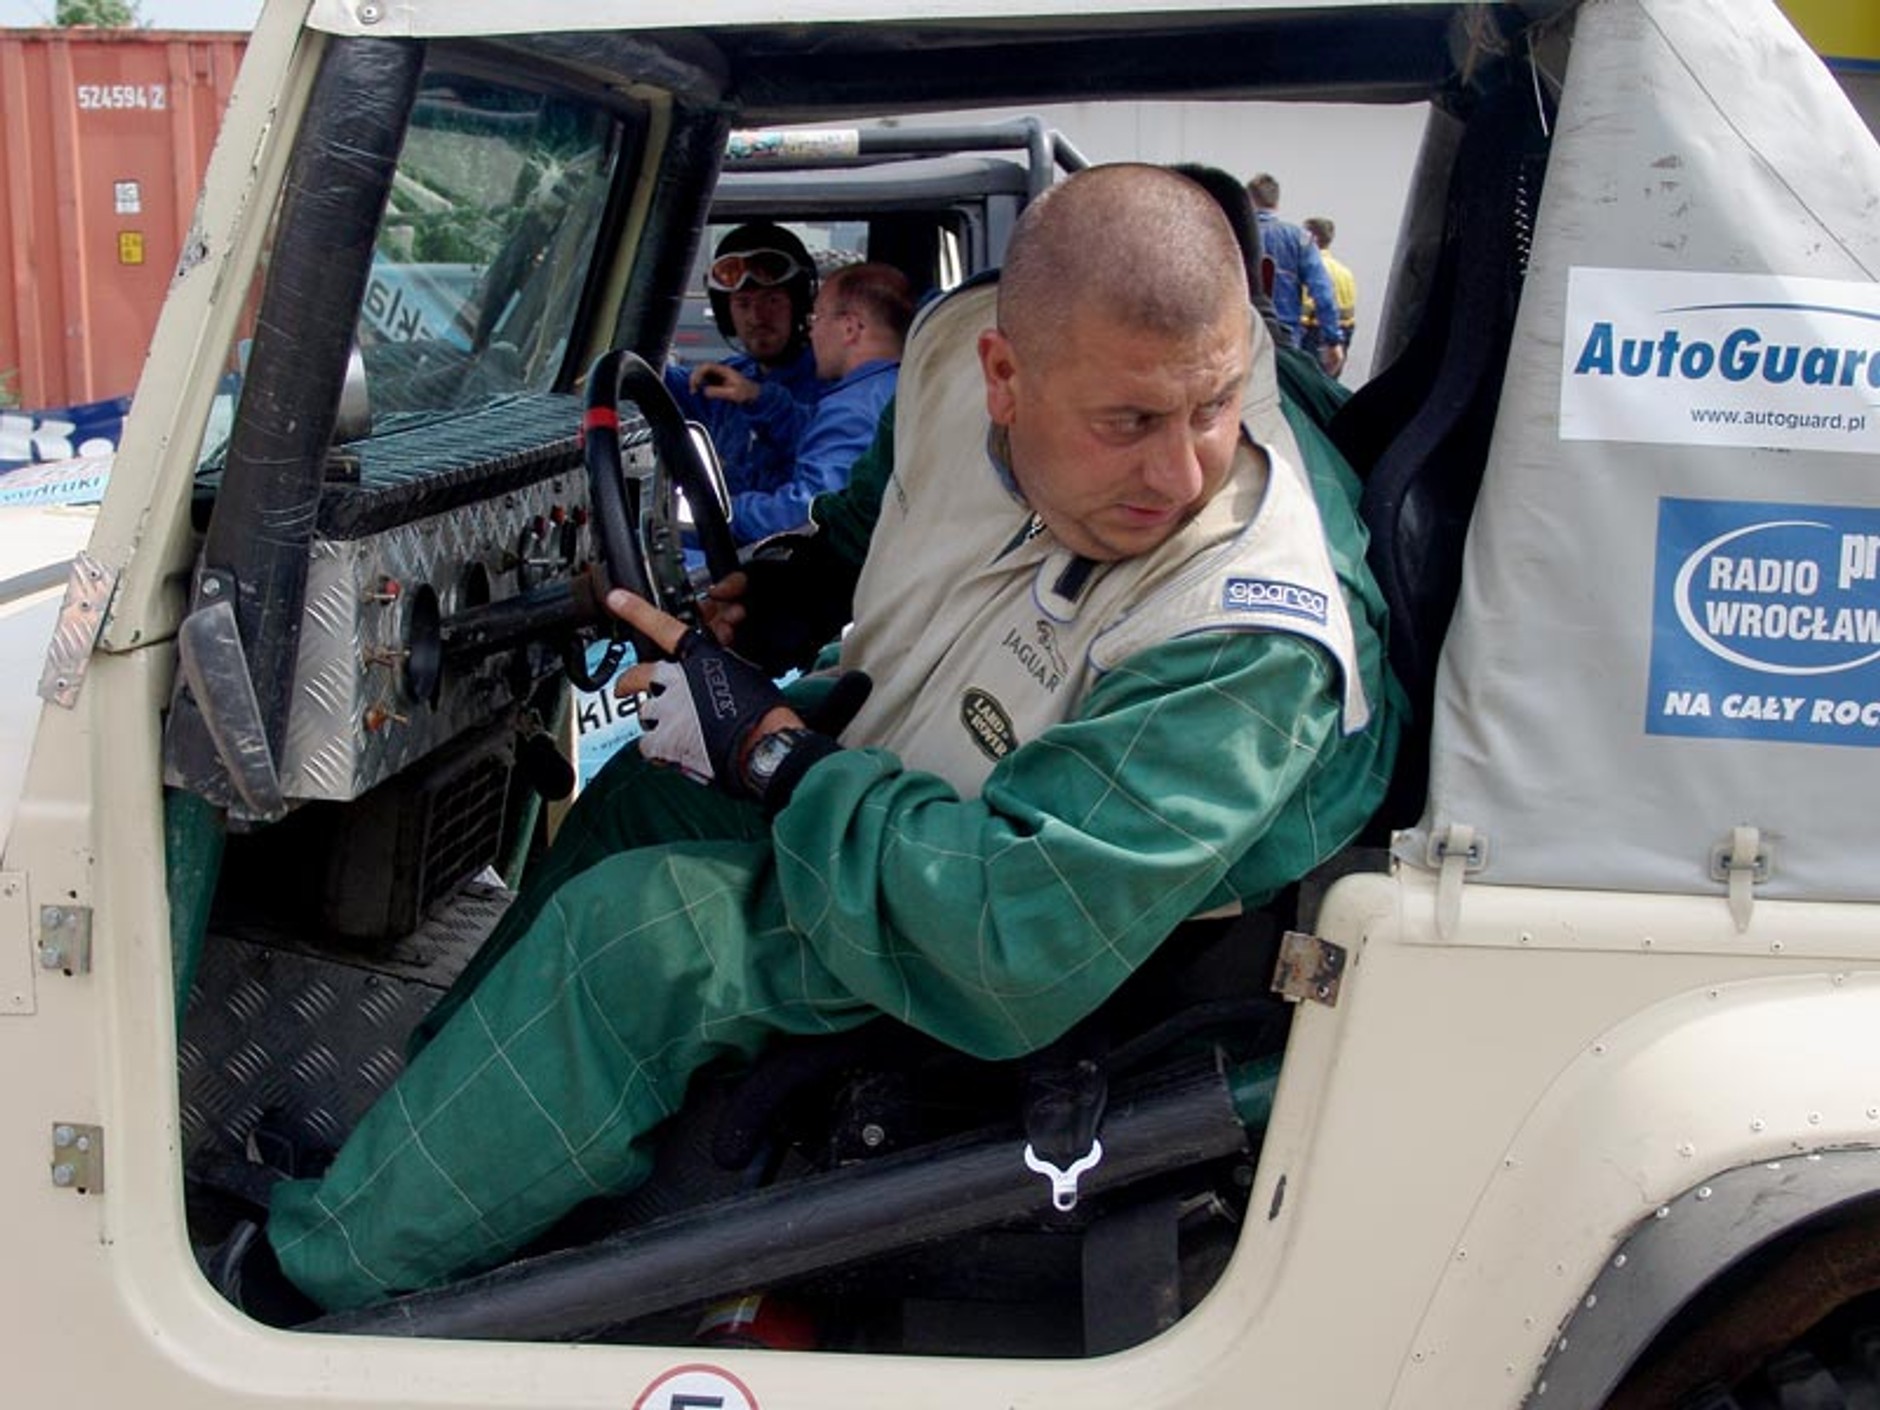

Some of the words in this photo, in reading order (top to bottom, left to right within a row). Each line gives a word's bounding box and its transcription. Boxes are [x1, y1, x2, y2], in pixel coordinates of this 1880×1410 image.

[78, 85, 147, 108] 524594
[1691, 408, 1866, 433] www.autoguard.pl
[1709, 556, 1818, 595] RADIO
[1229, 582, 1325, 619] sparco
[1706, 601, 1880, 644] WROCŁAW
[1002, 627, 1060, 694] JAGUAR
[975, 698, 1005, 733] LAND
[1664, 691, 1712, 717] NA
[1721, 694, 1805, 721] CAŁY
[971, 714, 1008, 757] ROVER
